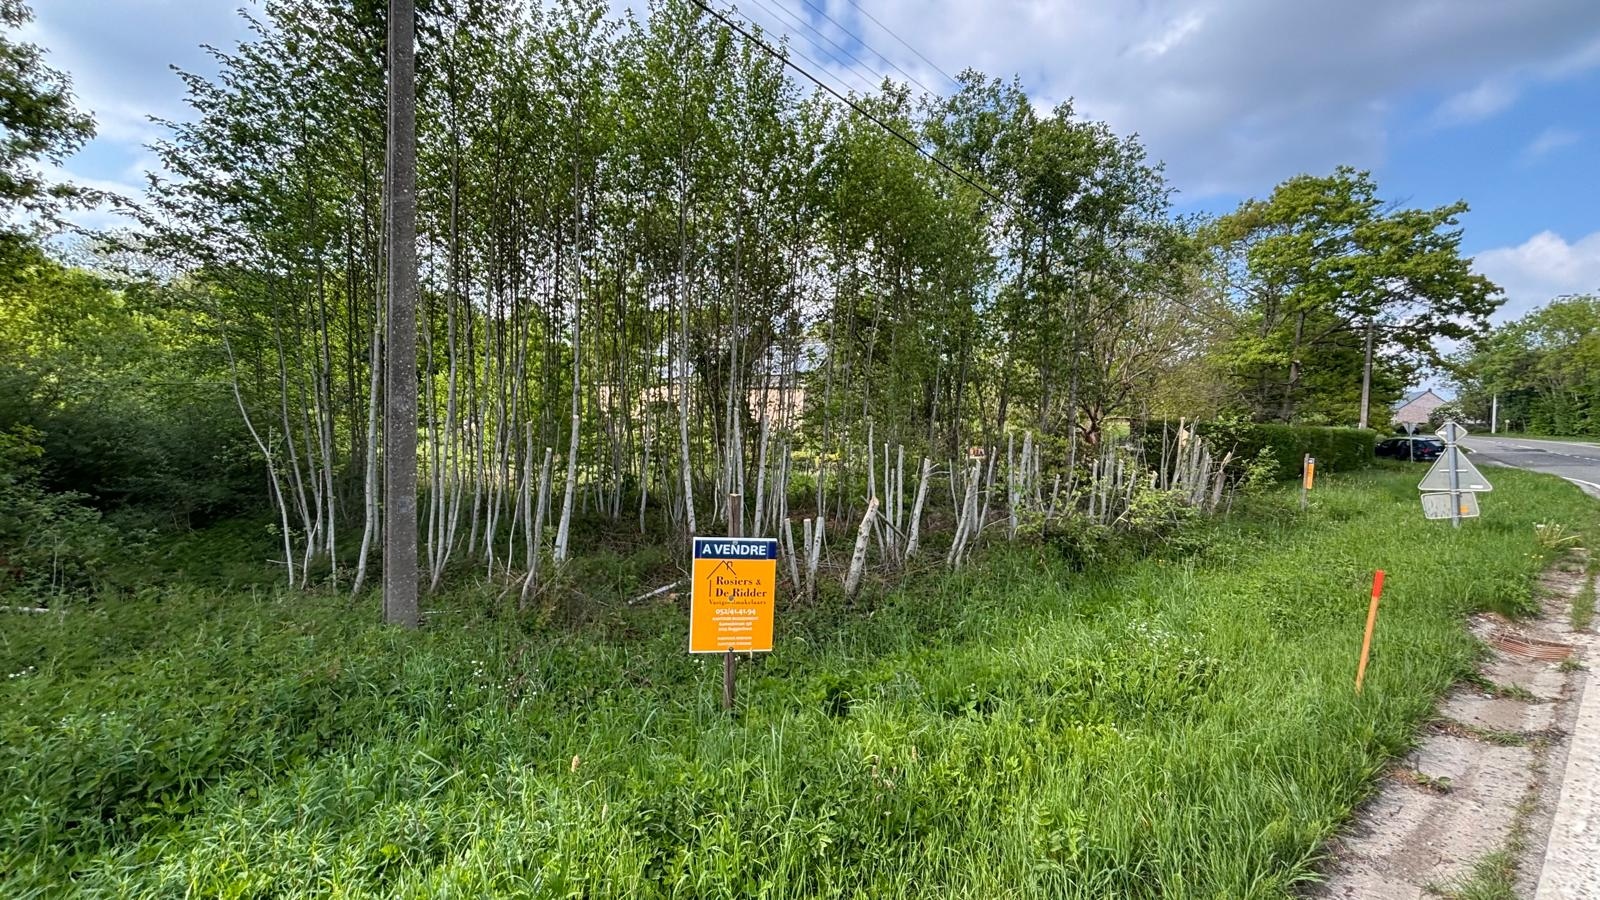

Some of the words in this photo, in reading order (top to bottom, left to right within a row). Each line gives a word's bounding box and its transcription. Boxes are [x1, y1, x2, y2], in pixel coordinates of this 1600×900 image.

[702, 544, 711, 554] A
[714, 544, 767, 556] VENDRE
[716, 576, 753, 585] Rosiers
[716, 588, 729, 597] De
[732, 588, 767, 597] Ridder
